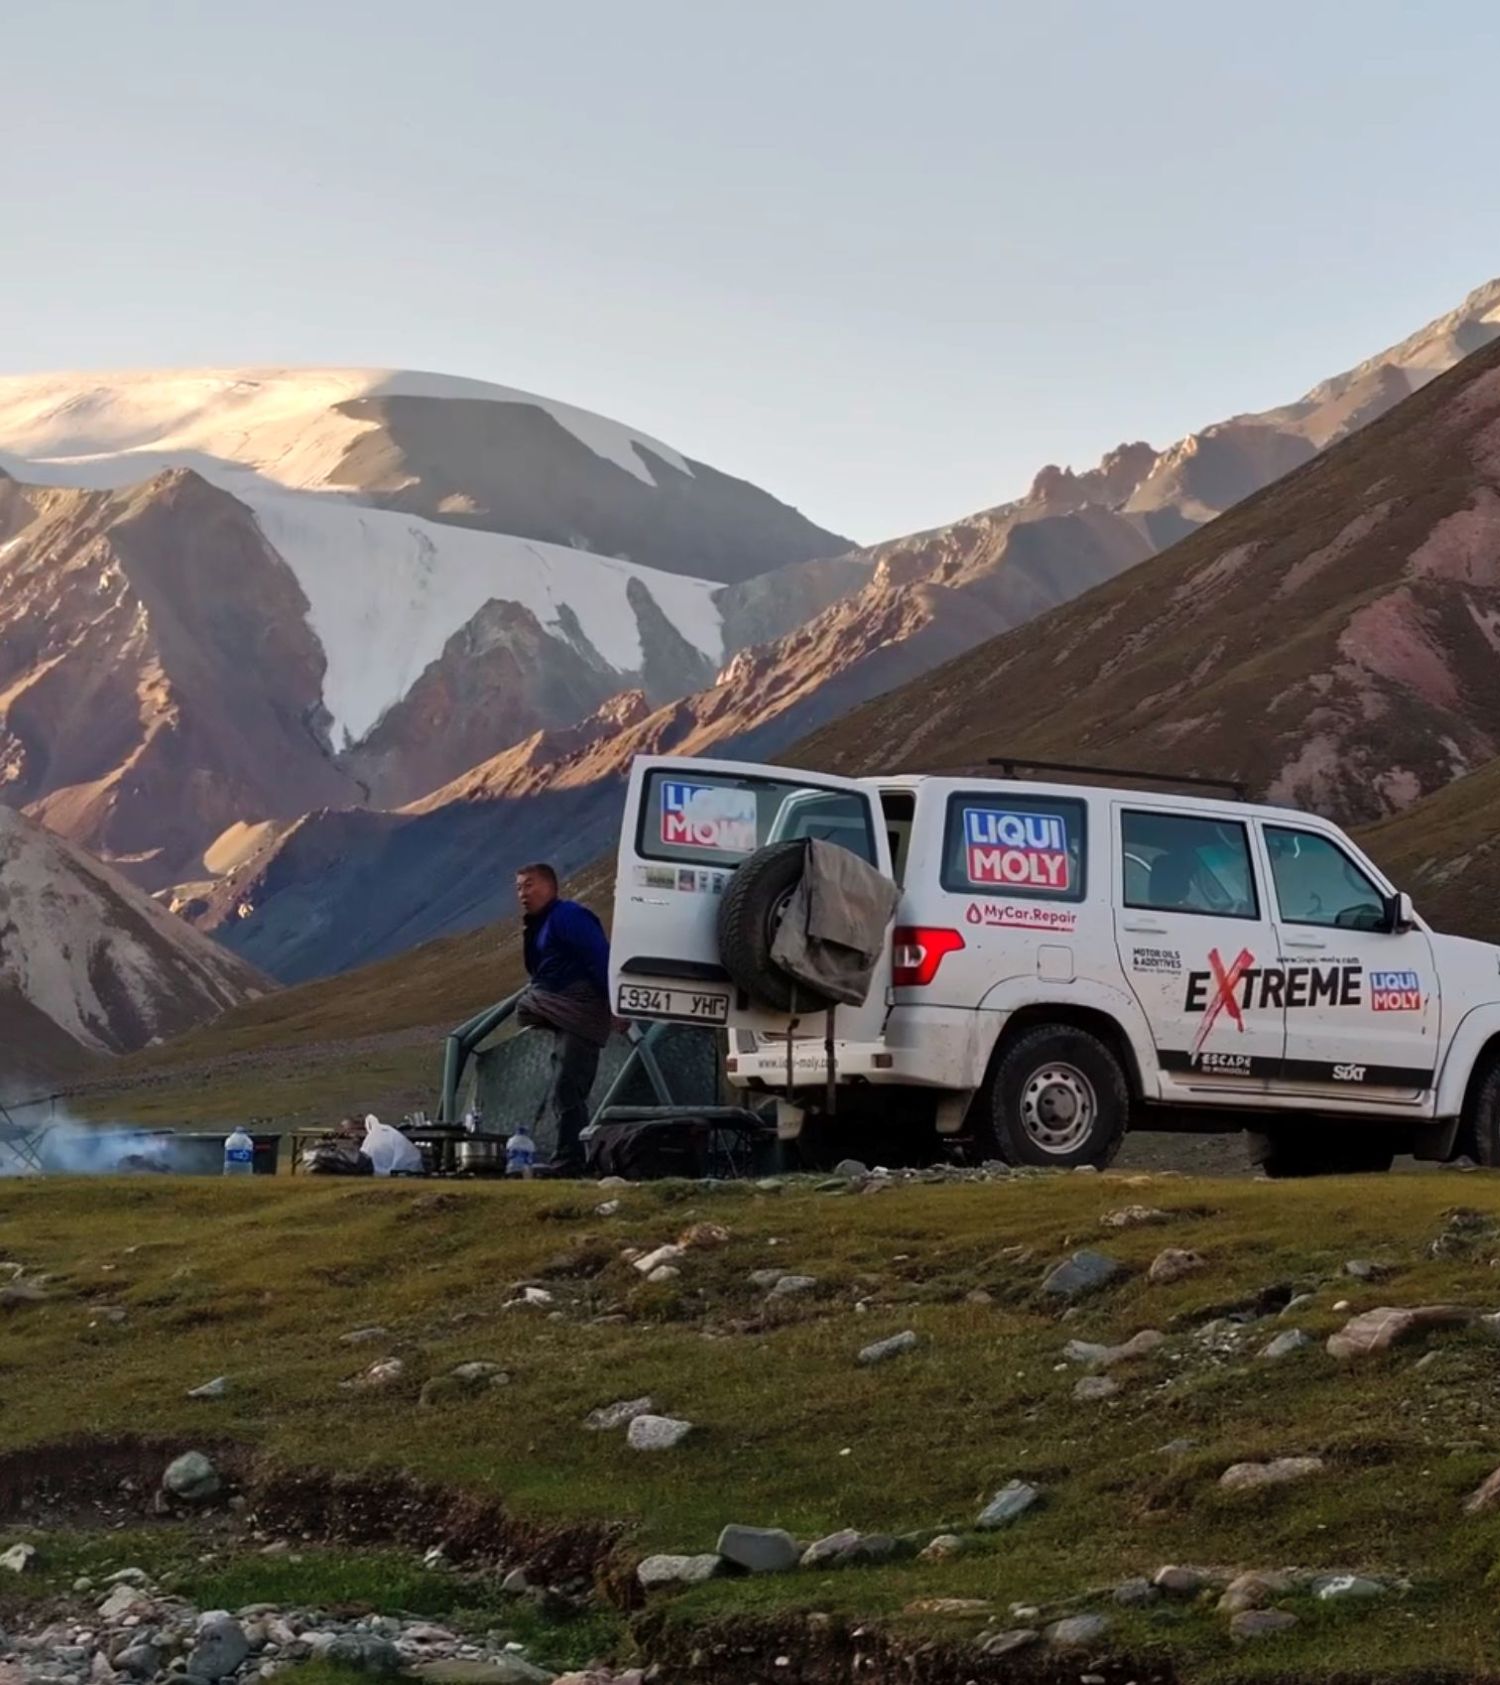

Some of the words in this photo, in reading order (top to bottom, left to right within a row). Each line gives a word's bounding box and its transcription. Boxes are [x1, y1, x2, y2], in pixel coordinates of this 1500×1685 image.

[970, 813, 1061, 849] LIQUI
[973, 848, 1064, 885] MOLY
[984, 904, 1077, 925] MyCar.Repair
[1371, 973, 1418, 991] LIQUI
[628, 989, 671, 1011] 9341
[691, 996, 724, 1015] УНГ
[1374, 991, 1420, 1010] MOLY
